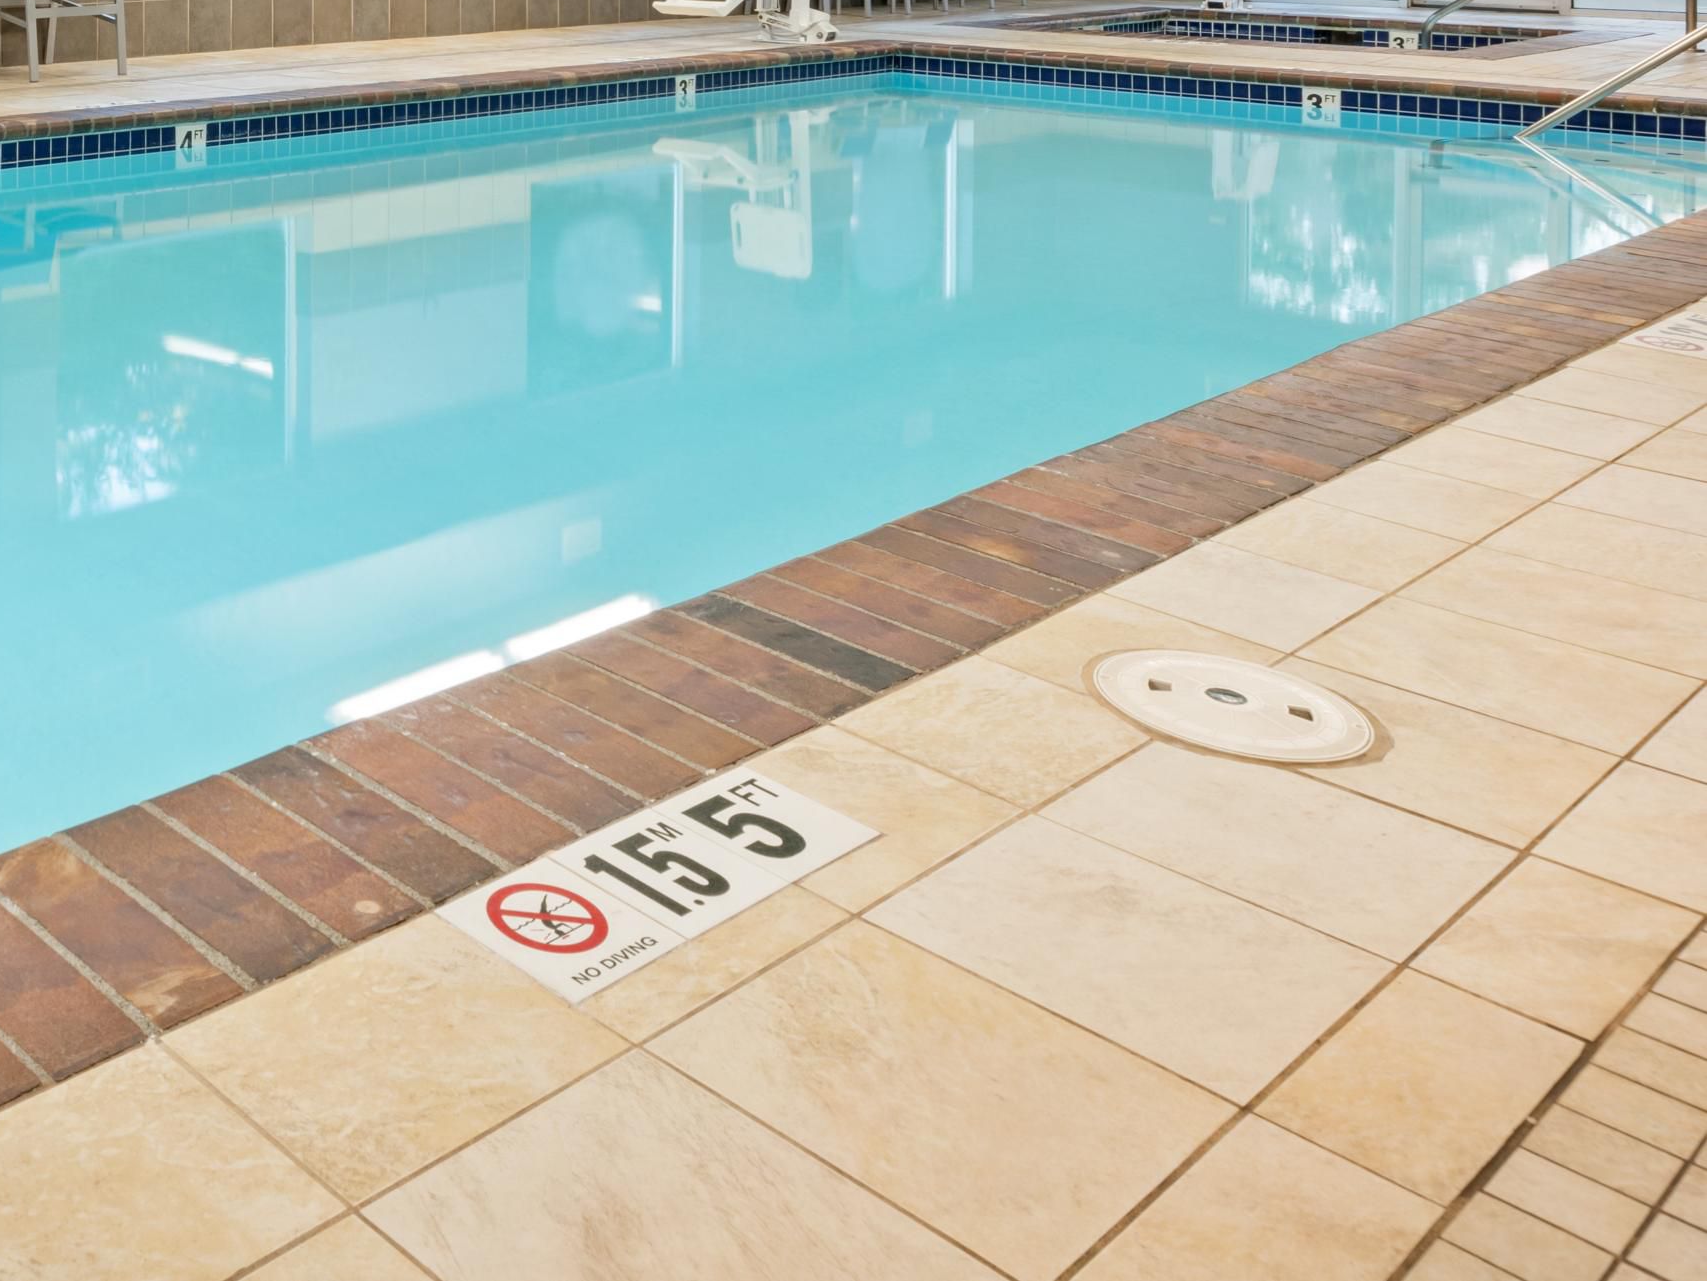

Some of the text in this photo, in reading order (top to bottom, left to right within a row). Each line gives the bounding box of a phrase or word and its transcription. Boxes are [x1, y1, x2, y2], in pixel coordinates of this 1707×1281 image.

[679, 80, 687, 95] 3
[1307, 94, 1336, 108] 3 FT
[194, 129, 204, 139] FT
[681, 778, 807, 858] 5 FT
[583, 822, 731, 917] 1.5 M
[571, 936, 659, 985] NO DIVING
